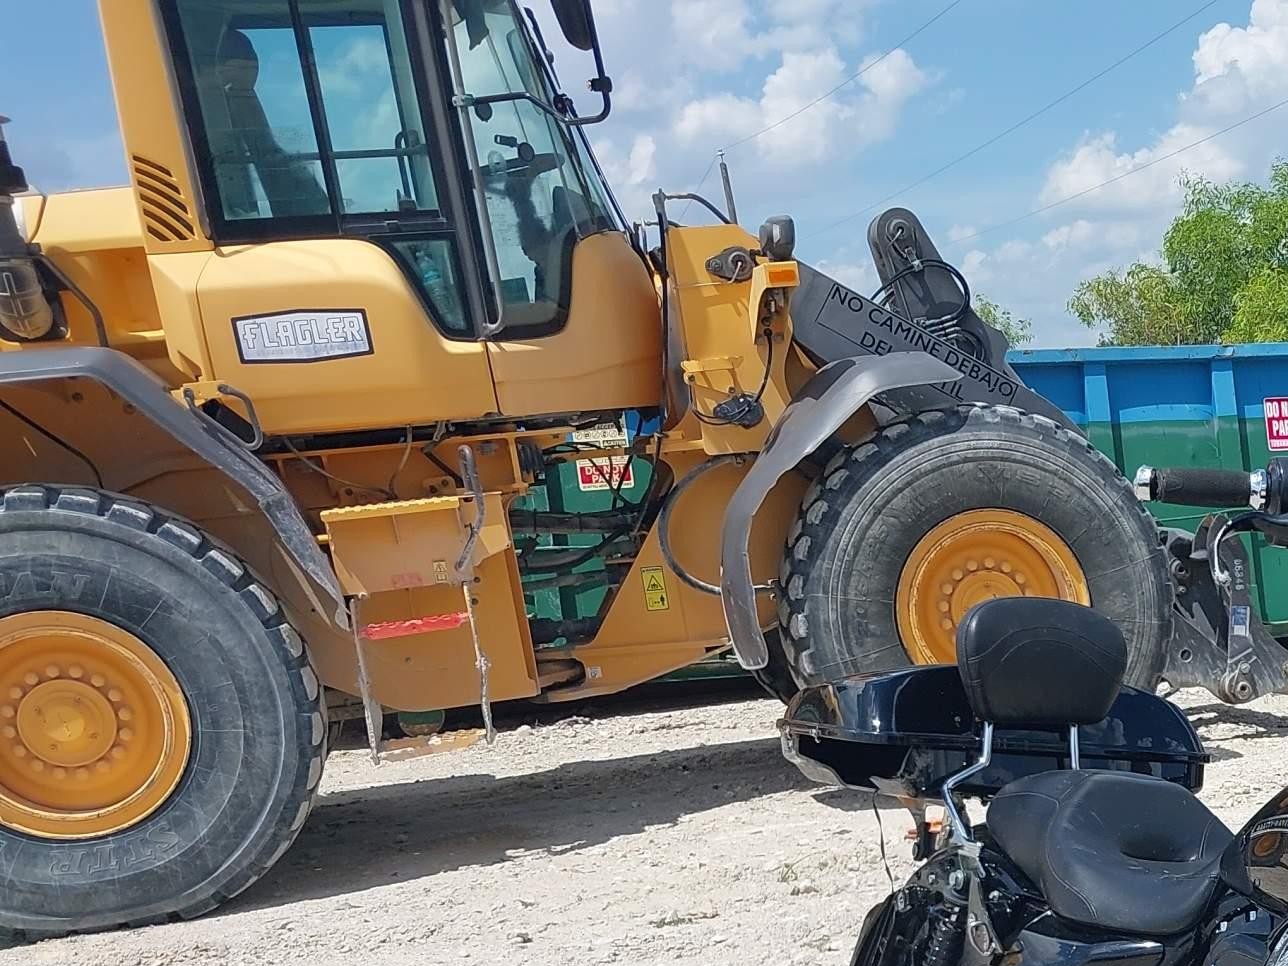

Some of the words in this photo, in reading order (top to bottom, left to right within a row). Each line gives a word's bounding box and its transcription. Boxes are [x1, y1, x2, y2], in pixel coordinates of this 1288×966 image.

[243, 316, 363, 349] FLAGLER
[831, 286, 864, 313] NO
[868, 308, 943, 358] CAMINE
[943, 350, 1014, 397] DEBAJO
[1266, 401, 1280, 418] DO
